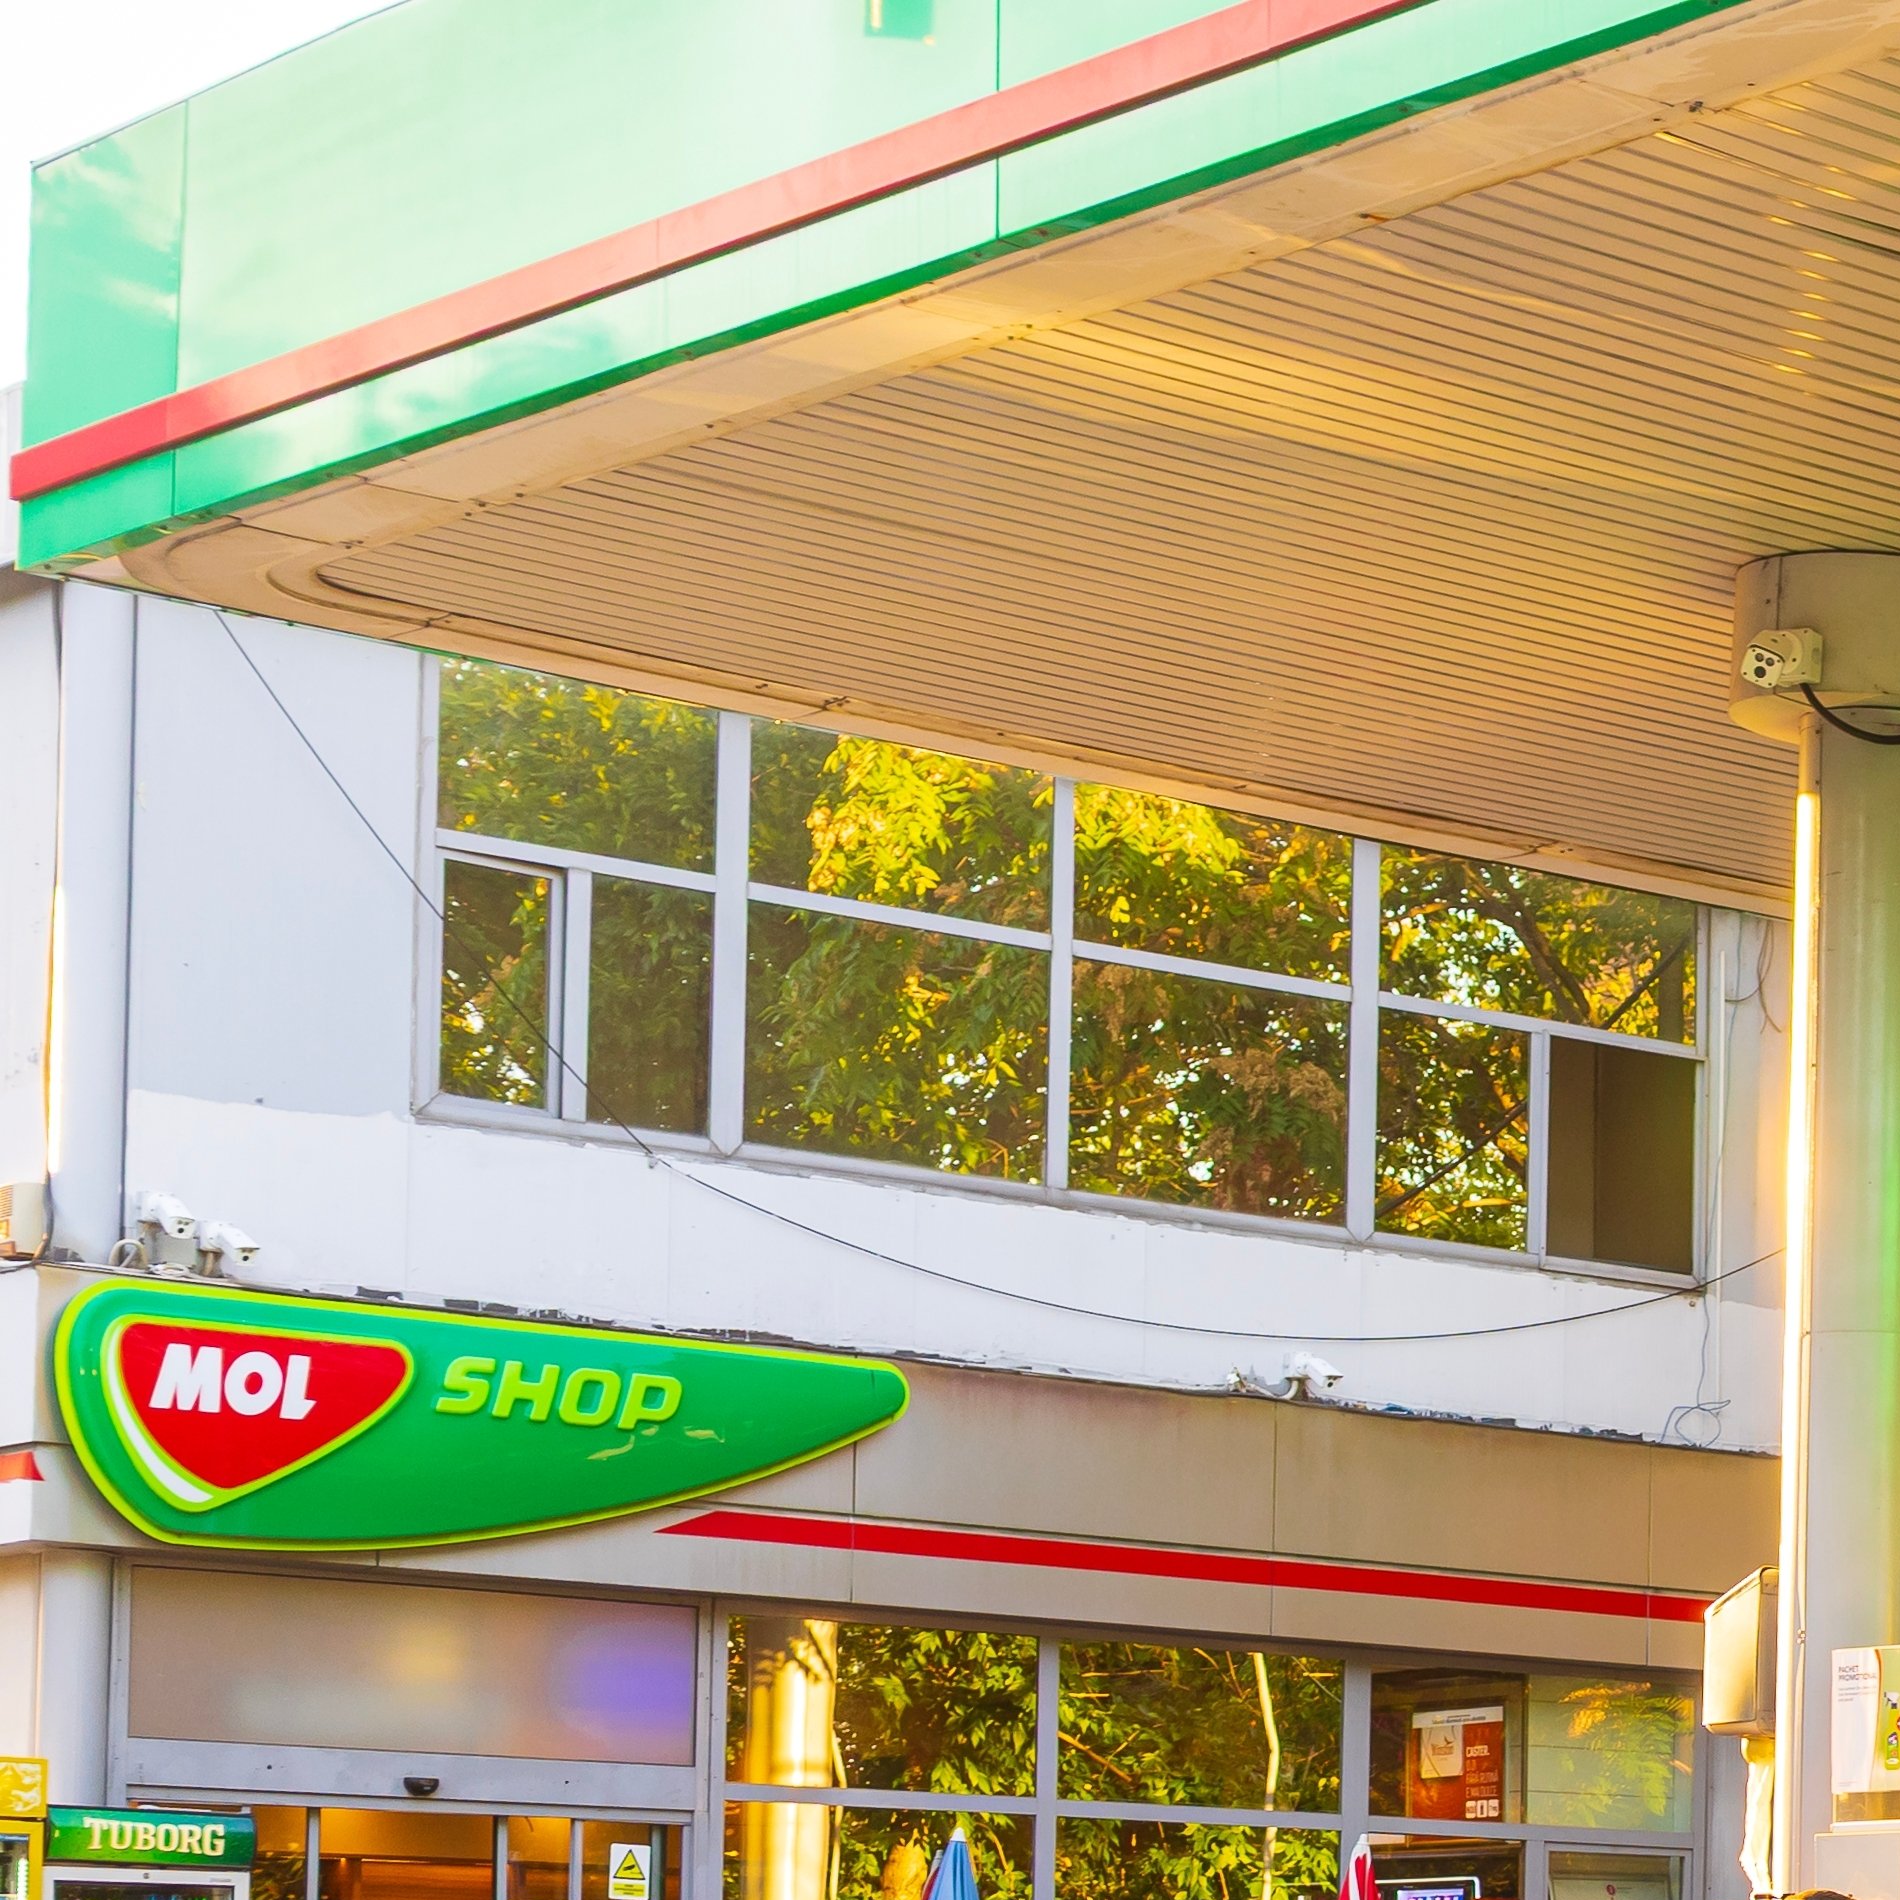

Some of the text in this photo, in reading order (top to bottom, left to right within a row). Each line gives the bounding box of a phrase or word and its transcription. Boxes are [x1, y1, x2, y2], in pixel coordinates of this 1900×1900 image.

[150, 1344, 317, 1421] MOL
[434, 1355, 683, 1430] SHOP
[83, 1816, 226, 1857] TUBORG
